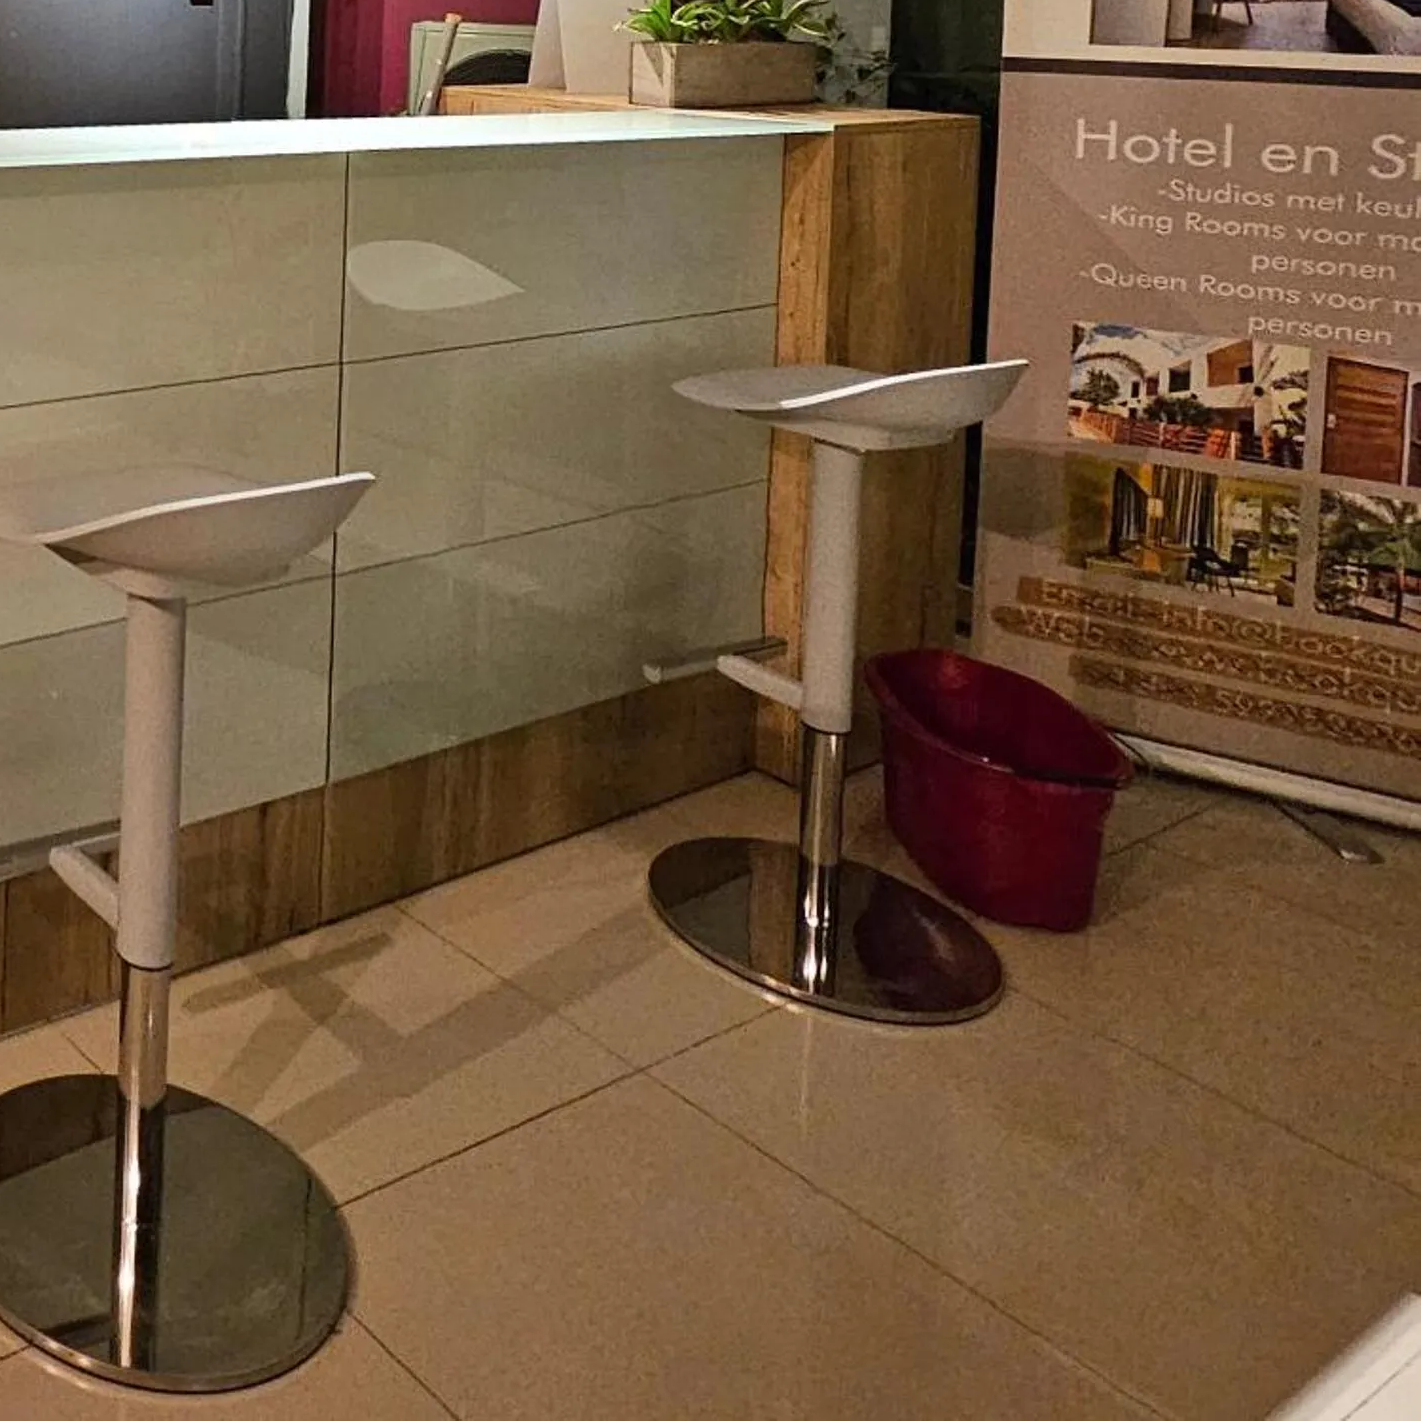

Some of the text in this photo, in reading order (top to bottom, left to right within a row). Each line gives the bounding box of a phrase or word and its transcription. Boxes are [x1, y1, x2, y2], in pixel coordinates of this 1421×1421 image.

[1075, 118, 1234, 168] Hotel
[1260, 143, 1339, 176] en
[1158, 179, 1276, 208] -Studios
[1286, 192, 1345, 213] met
[1098, 204, 1173, 235] -King
[1185, 211, 1287, 240] Rooms
[1296, 227, 1367, 246] voor
[1251, 255, 1397, 281] personen
[1198, 274, 1301, 305] Rooms
[1311, 291, 1383, 312] voor
[1247, 315, 1393, 346] personen
